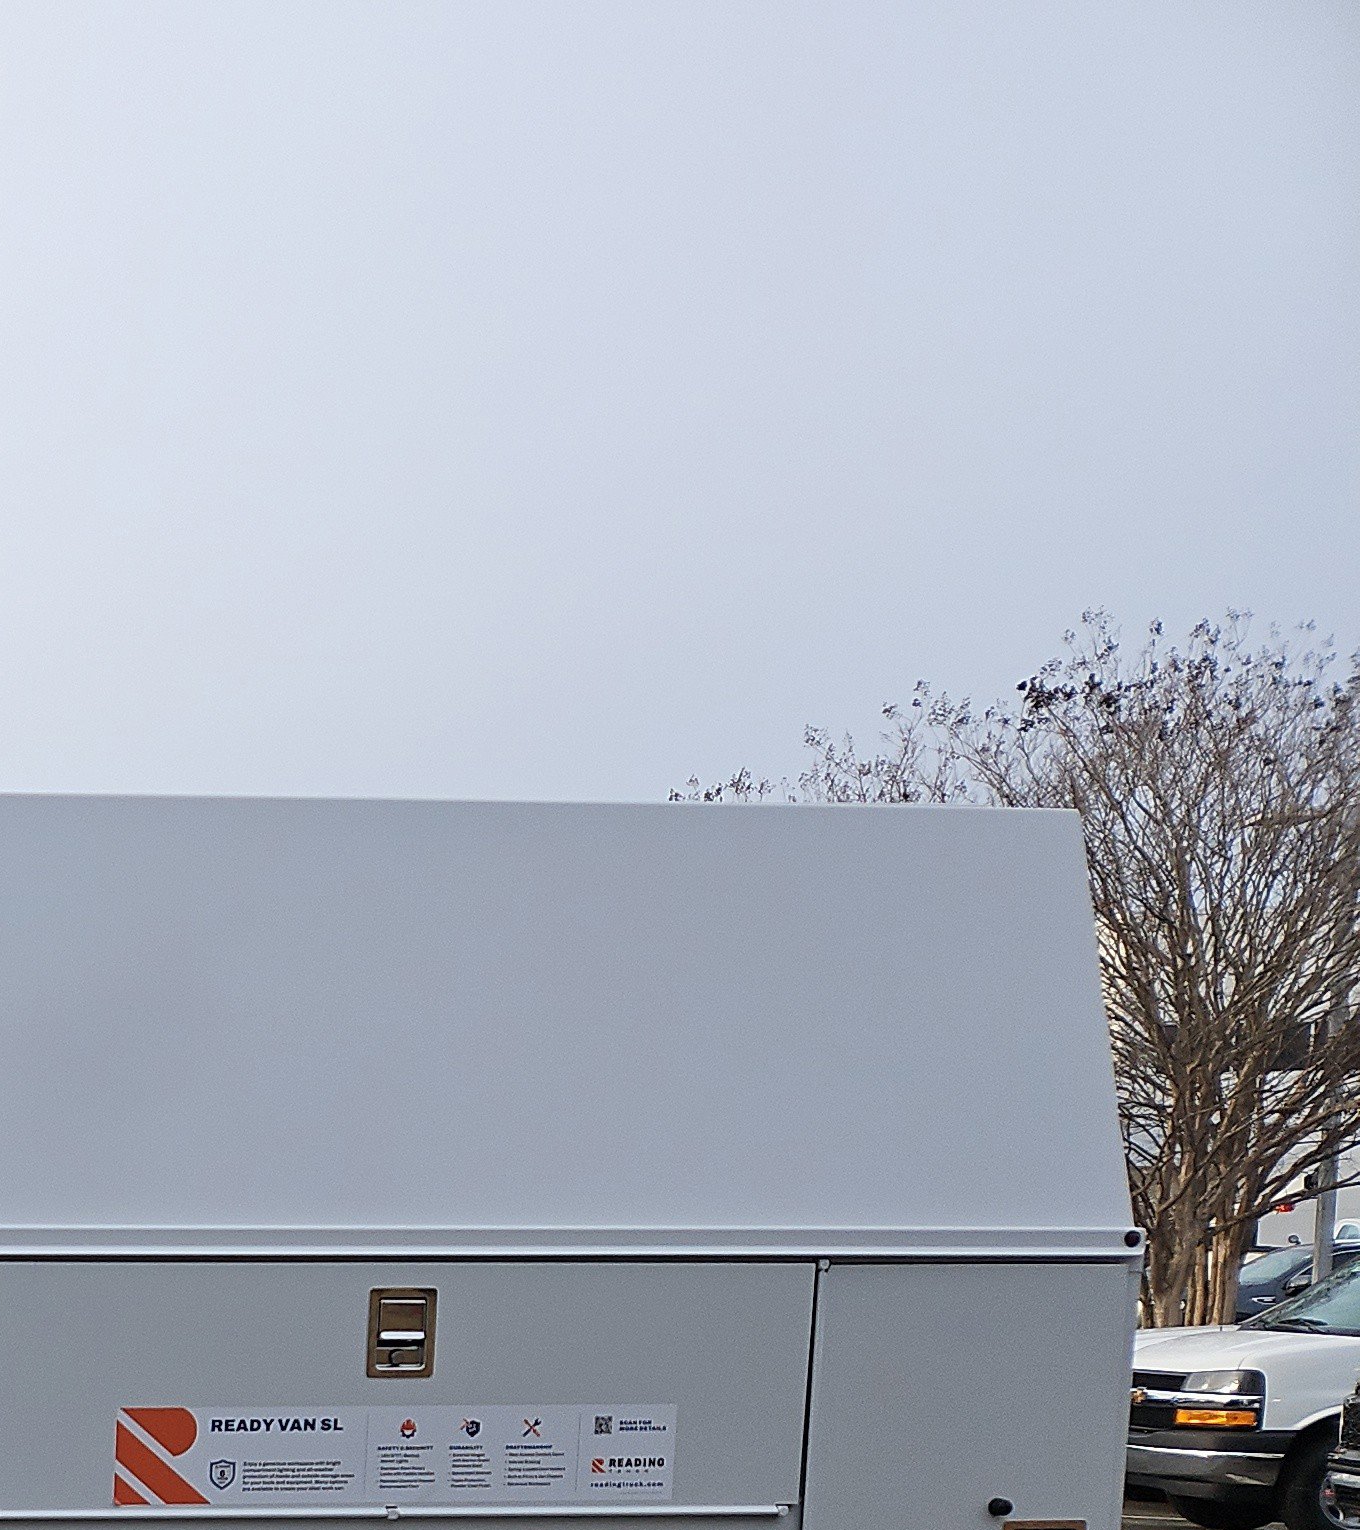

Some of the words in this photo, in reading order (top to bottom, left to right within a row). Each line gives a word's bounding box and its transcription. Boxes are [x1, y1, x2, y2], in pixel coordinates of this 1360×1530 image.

[211, 1419, 274, 1432] READY
[278, 1418, 316, 1431] VAN
[320, 1418, 344, 1431] SL
